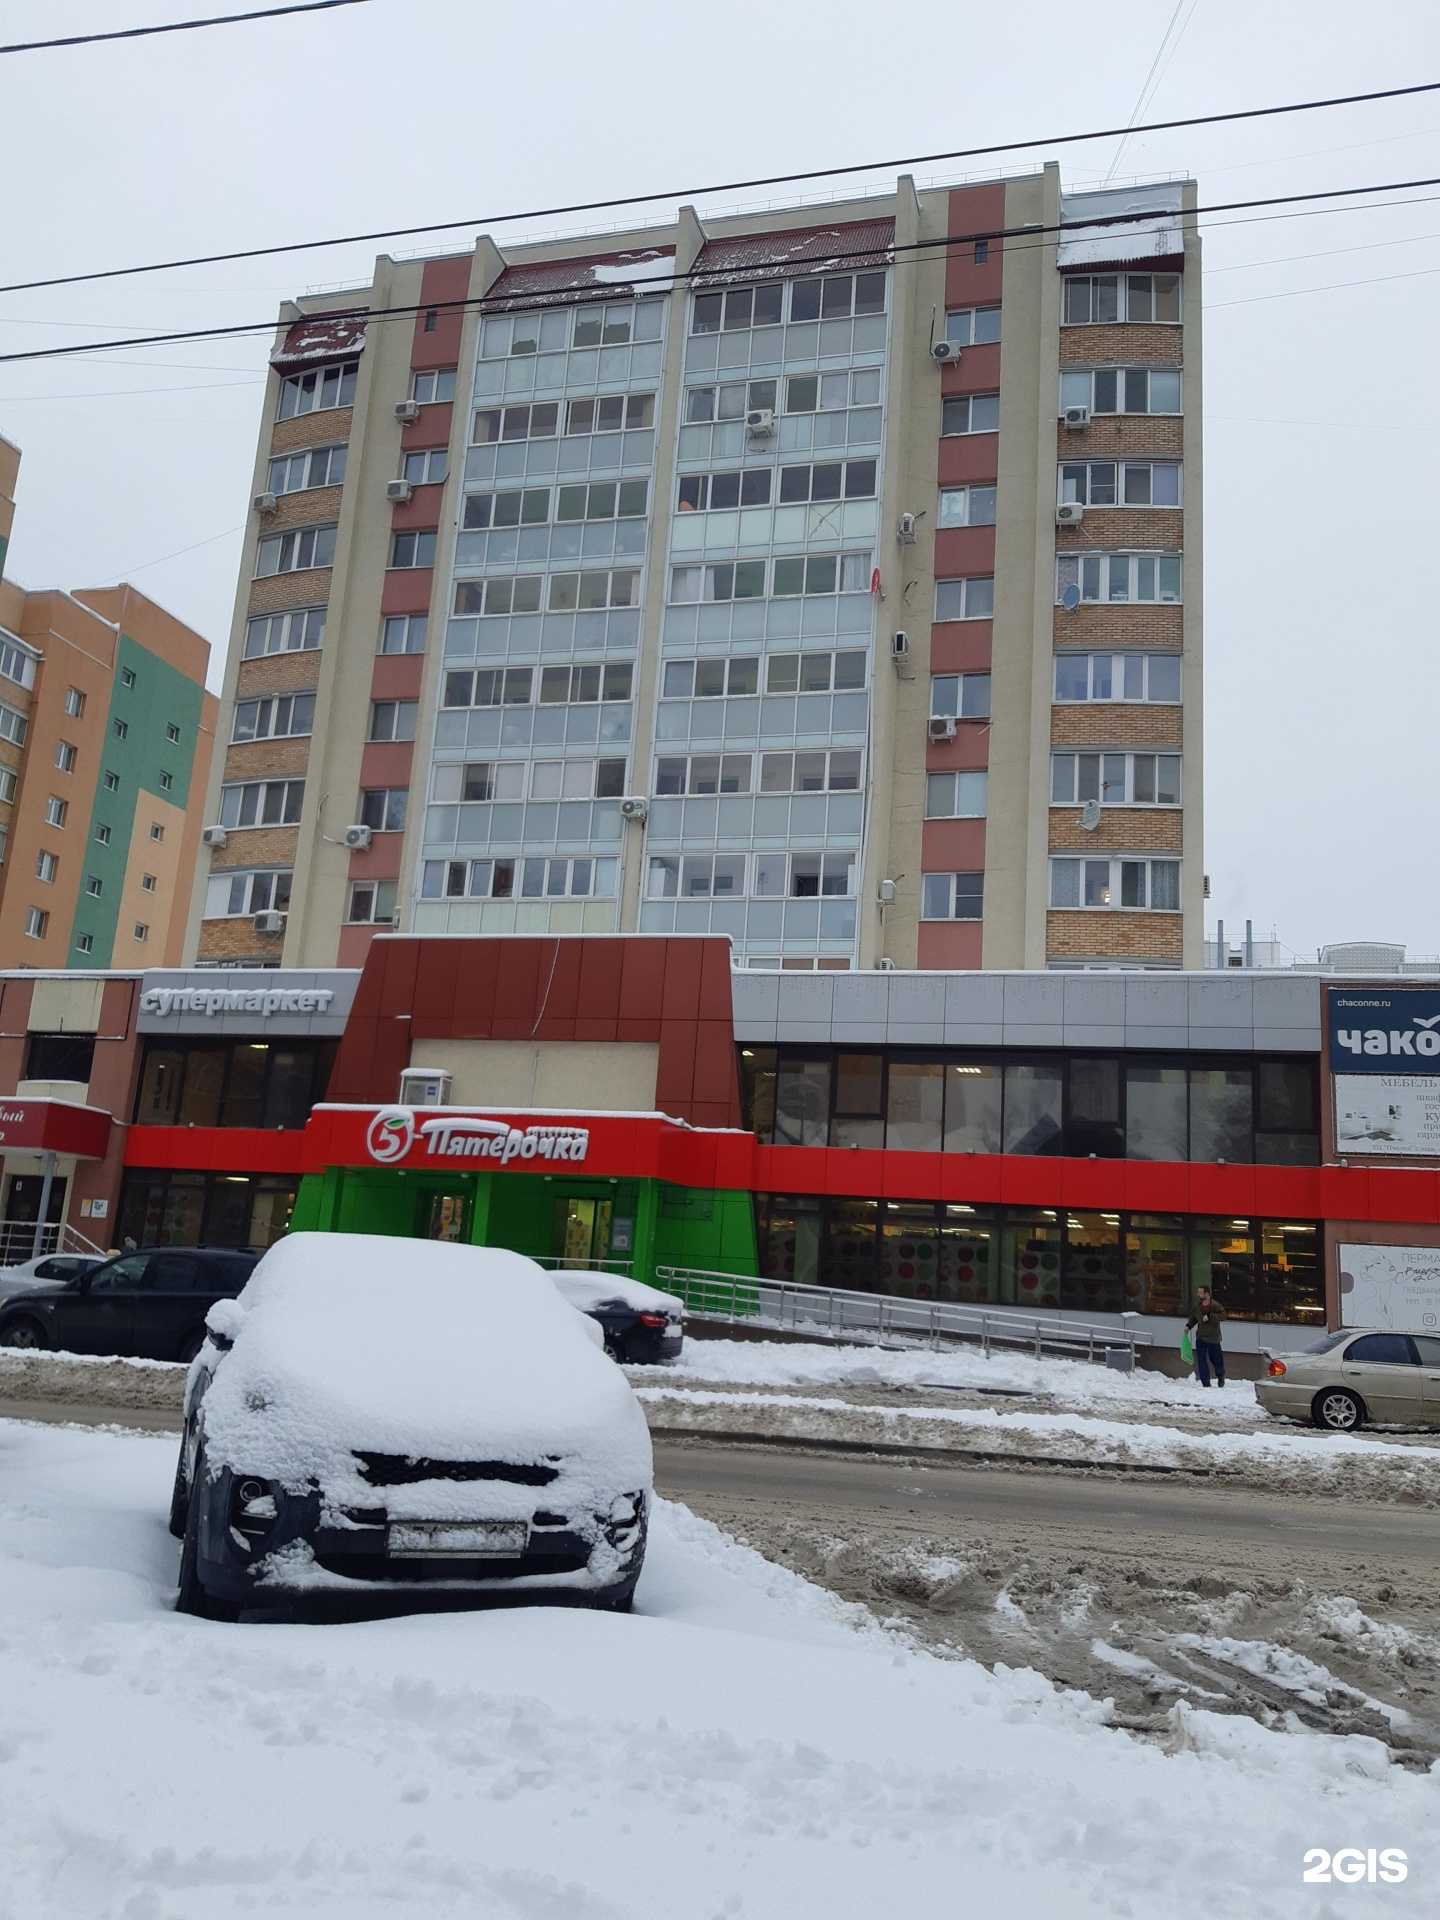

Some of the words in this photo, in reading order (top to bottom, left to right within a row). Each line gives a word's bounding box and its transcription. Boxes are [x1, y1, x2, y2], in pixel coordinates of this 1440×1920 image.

[141, 988, 334, 1016] супермаркет
[1337, 999, 1391, 1008] chaconne.ru
[373, 1117, 408, 1160] 5
